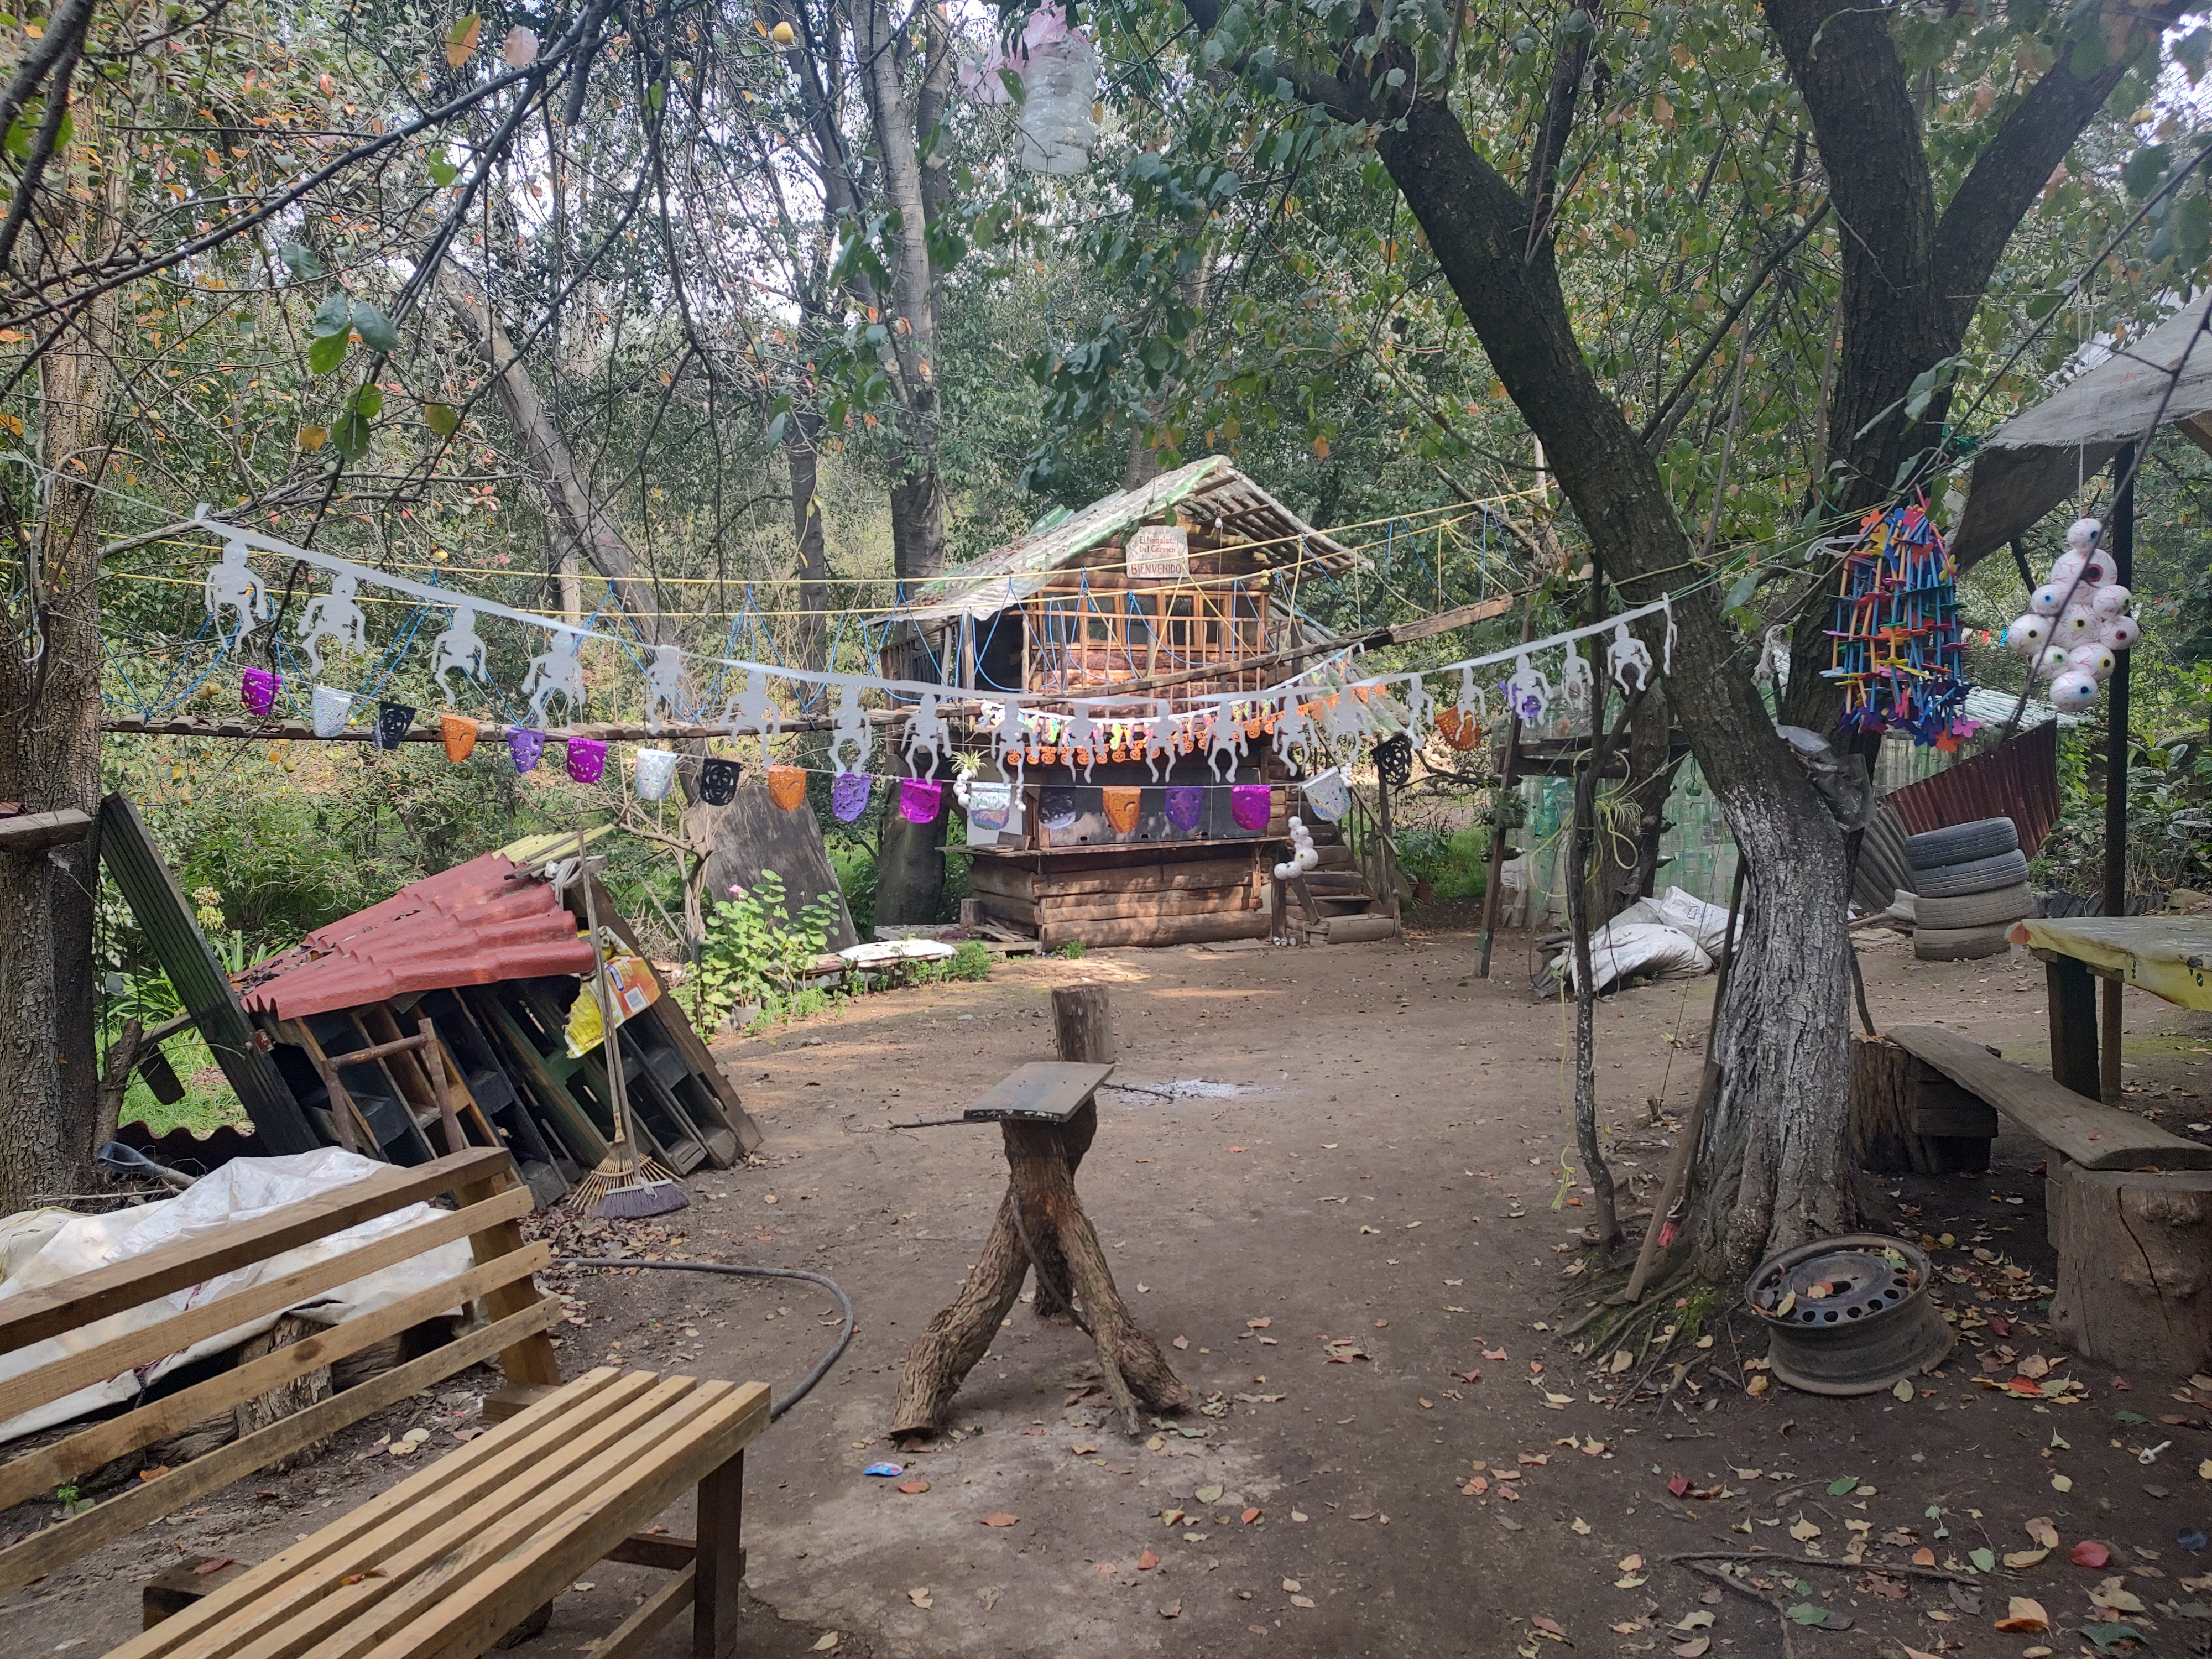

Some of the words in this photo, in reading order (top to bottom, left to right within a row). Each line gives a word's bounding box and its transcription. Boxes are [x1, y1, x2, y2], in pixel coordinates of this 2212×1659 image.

[1139, 535, 1145, 544] El
[1139, 545, 1149, 553] Del
[1151, 545, 1176, 553] Carmen
[1131, 564, 1181, 575] BIENVENIDO
